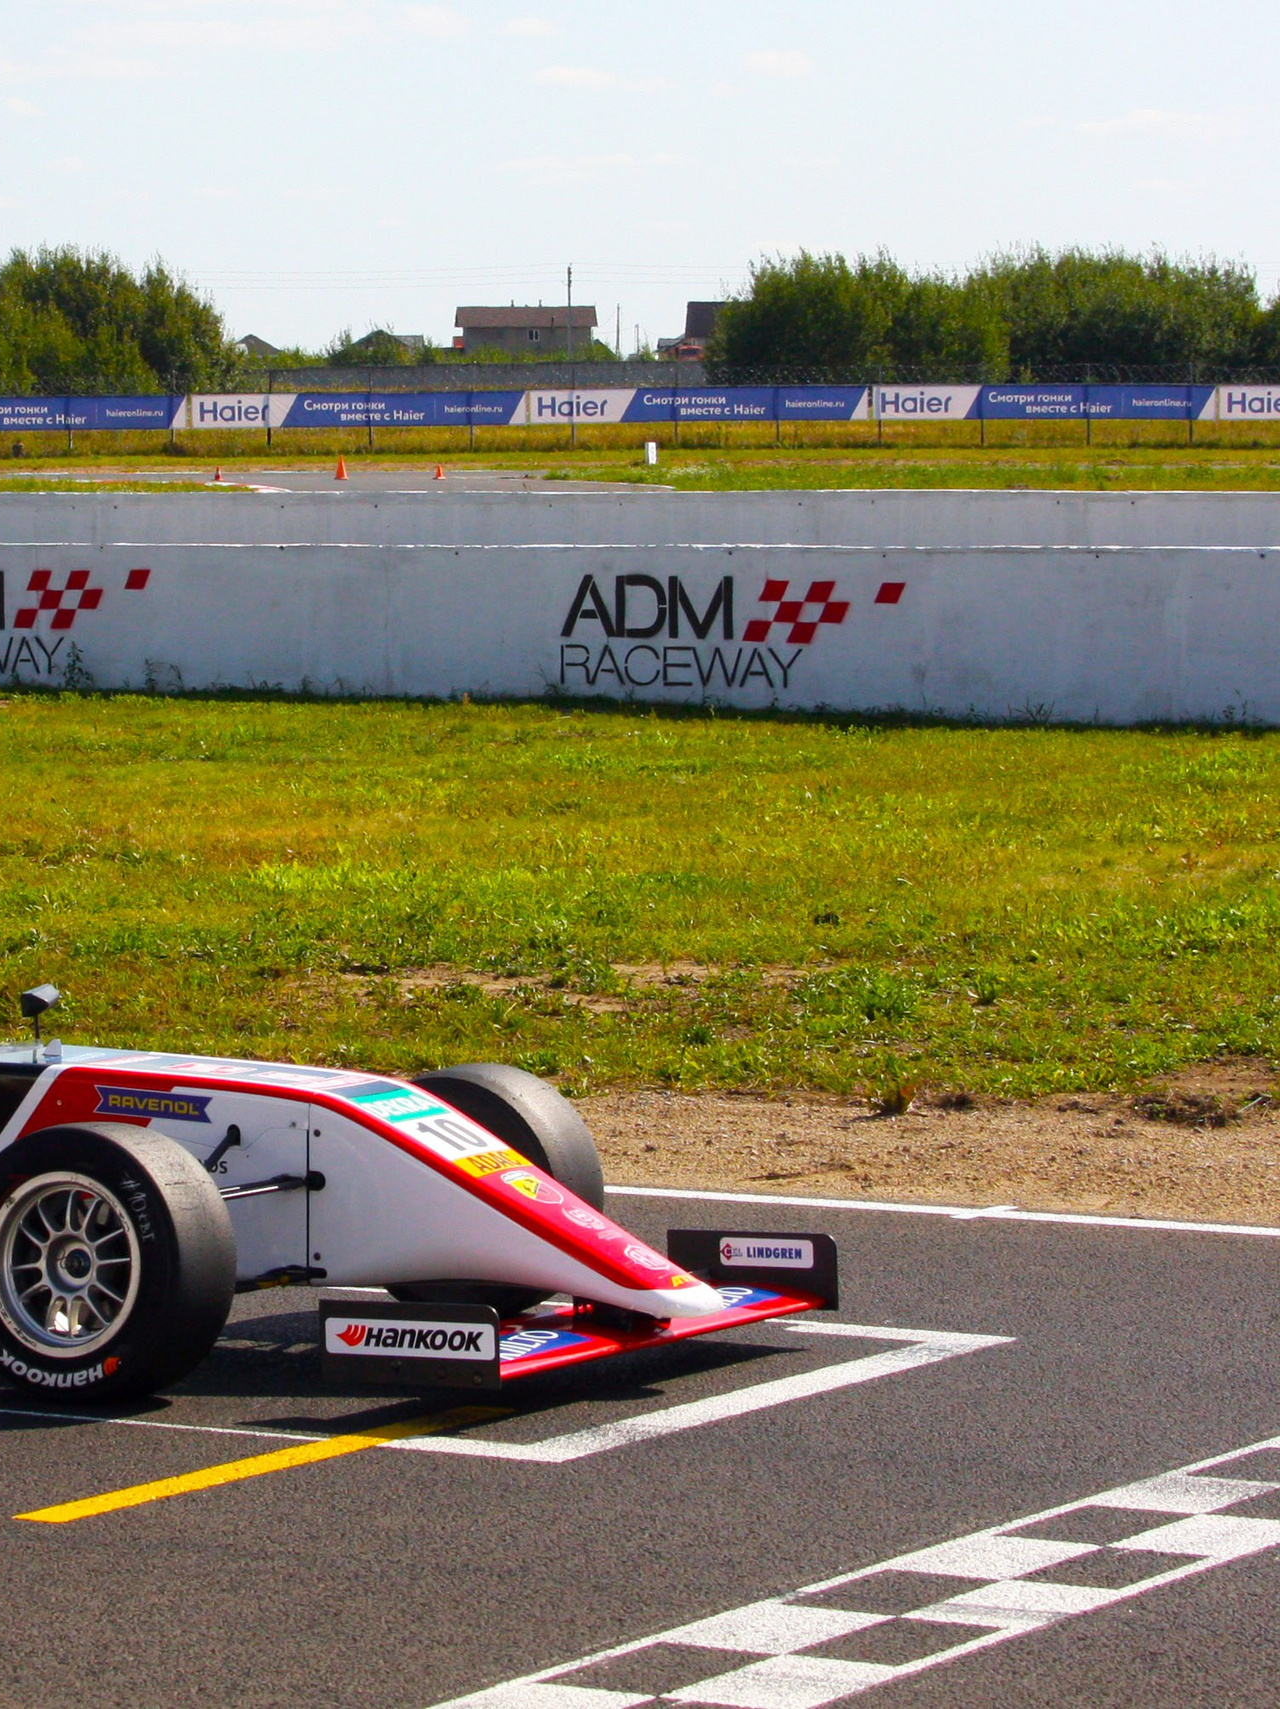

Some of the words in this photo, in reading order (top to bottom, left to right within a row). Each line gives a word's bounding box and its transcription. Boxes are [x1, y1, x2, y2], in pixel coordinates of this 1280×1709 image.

[644, 395, 689, 408] Смотри
[691, 396, 726, 405] гонки
[785, 399, 845, 409] haieronline.ru
[880, 391, 952, 413] Haier
[988, 392, 1035, 405] Смотри
[1037, 393, 1072, 403] гонки
[1132, 398, 1192, 408] haieronline.ru
[14, 405, 48, 415] гонки
[199, 400, 269, 422] Haier
[304, 400, 348, 413] Смотри
[351, 401, 386, 411] гонки
[444, 404, 503, 414] haieronline.ru
[537, 395, 608, 418] Haier
[680, 405, 722, 416] вместе
[724, 407, 731, 415] с
[734, 404, 766, 415] Haier
[1026, 403, 1068, 414] вместе
[1070, 404, 1077, 413] с
[1080, 402, 1112, 413] Haier
[3, 415, 44, 426] вместе
[46, 416, 53, 425] с
[56, 414, 87, 425] Haier
[106, 409, 164, 418] haieronline.ru
[340, 412, 383, 422] вместе
[384, 412, 391, 421] с
[394, 410, 425, 421] Haier
[560, 574, 733, 640] ADM
[560, 644, 803, 688] RACEWAY
[108, 1094, 200, 1116] RAVENOL
[417, 1118, 488, 1151] 10
[469, 1151, 520, 1173] ADAC
[746, 1246, 802, 1260] LINDGREN
